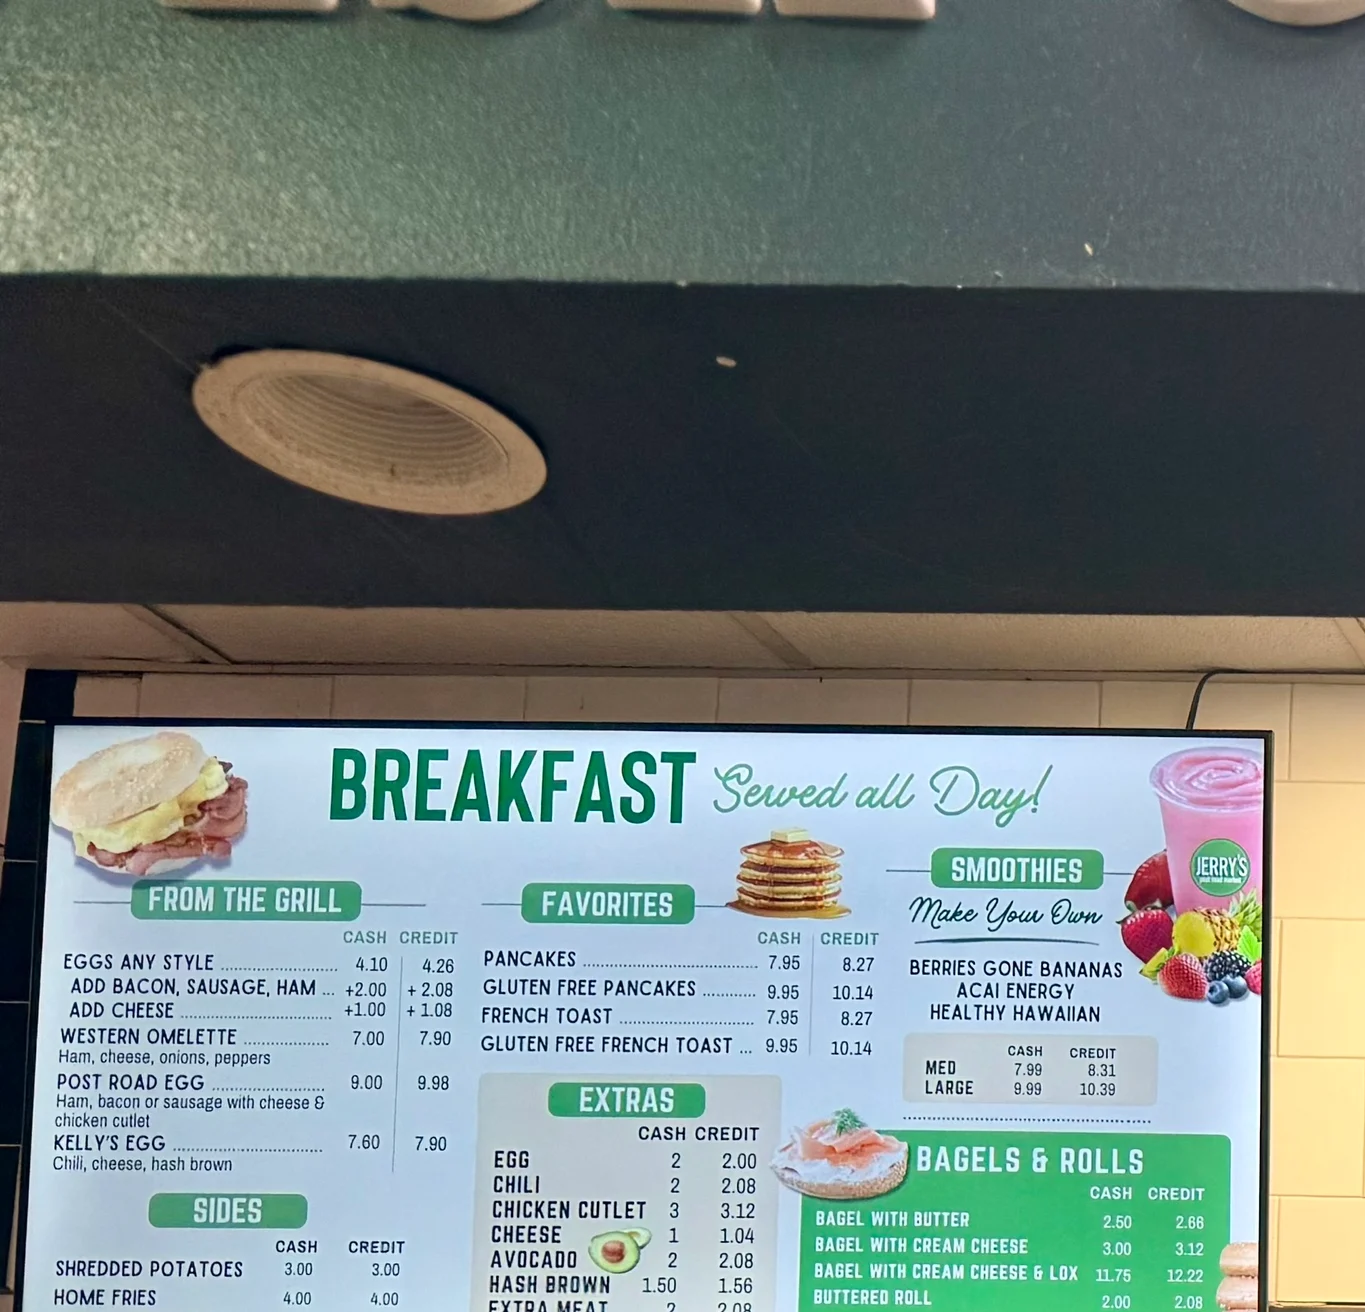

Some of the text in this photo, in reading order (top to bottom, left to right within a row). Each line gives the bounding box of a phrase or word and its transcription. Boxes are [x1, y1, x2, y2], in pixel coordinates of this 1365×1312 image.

[328, 748, 697, 825] BREAKFAST
[713, 763, 1053, 828] Served all Day!
[952, 857, 1082, 883] SMOOTHIES
[1195, 854, 1248, 877] JERRY'S
[149, 886, 341, 913] FROM THE GRILL
[542, 891, 673, 917] FAVORITES
[909, 897, 1103, 933] Make Your Own
[343, 931, 458, 944] CASH CREDIT
[64, 954, 454, 974] EGGS ANY STYLE 4.10 4.26
[484, 950, 874, 972] PANCAKES 7.95 8.27
[910, 959, 1122, 978] BERRIES GONE BANANAS
[59, 1049, 270, 1067] Ham, cheese, onions, peppers
[580, 1087, 674, 1113] EXTRAS
[925, 1080, 1115, 1096] LARGE 9.99 10.39
[917, 1146, 1143, 1174] BAGELS & ROLLS
[194, 1197, 262, 1223] SIDES
[56, 1260, 313, 1277] SHREDDED POTATOES 3.00
[815, 1263, 1203, 1283] BAGEL WITH CREAM CHEESE & LOX 11.75 12.22
